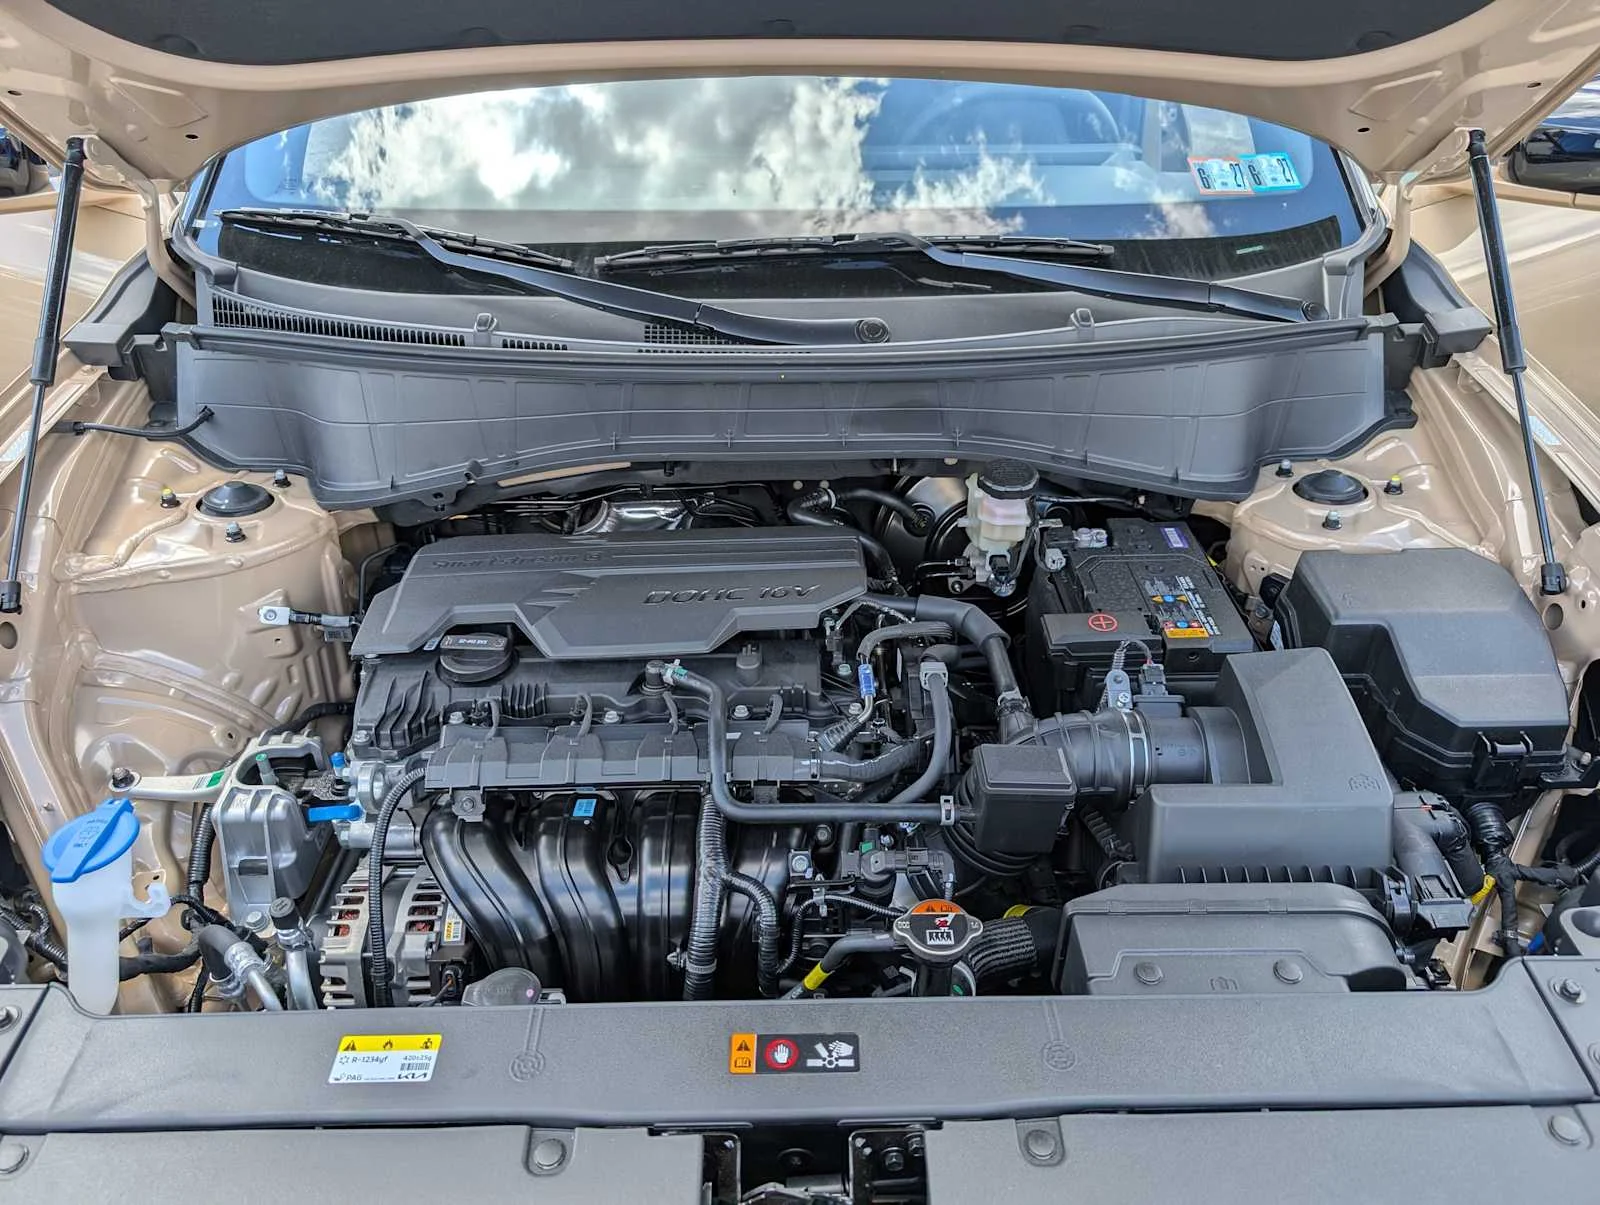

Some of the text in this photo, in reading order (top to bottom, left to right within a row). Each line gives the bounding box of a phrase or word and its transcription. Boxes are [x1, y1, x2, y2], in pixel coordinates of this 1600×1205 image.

[643, 584, 821, 604] DOHC 16V
[351, 1055, 388, 1065] R-1234yf
[397, 1072, 428, 1080] KIA
